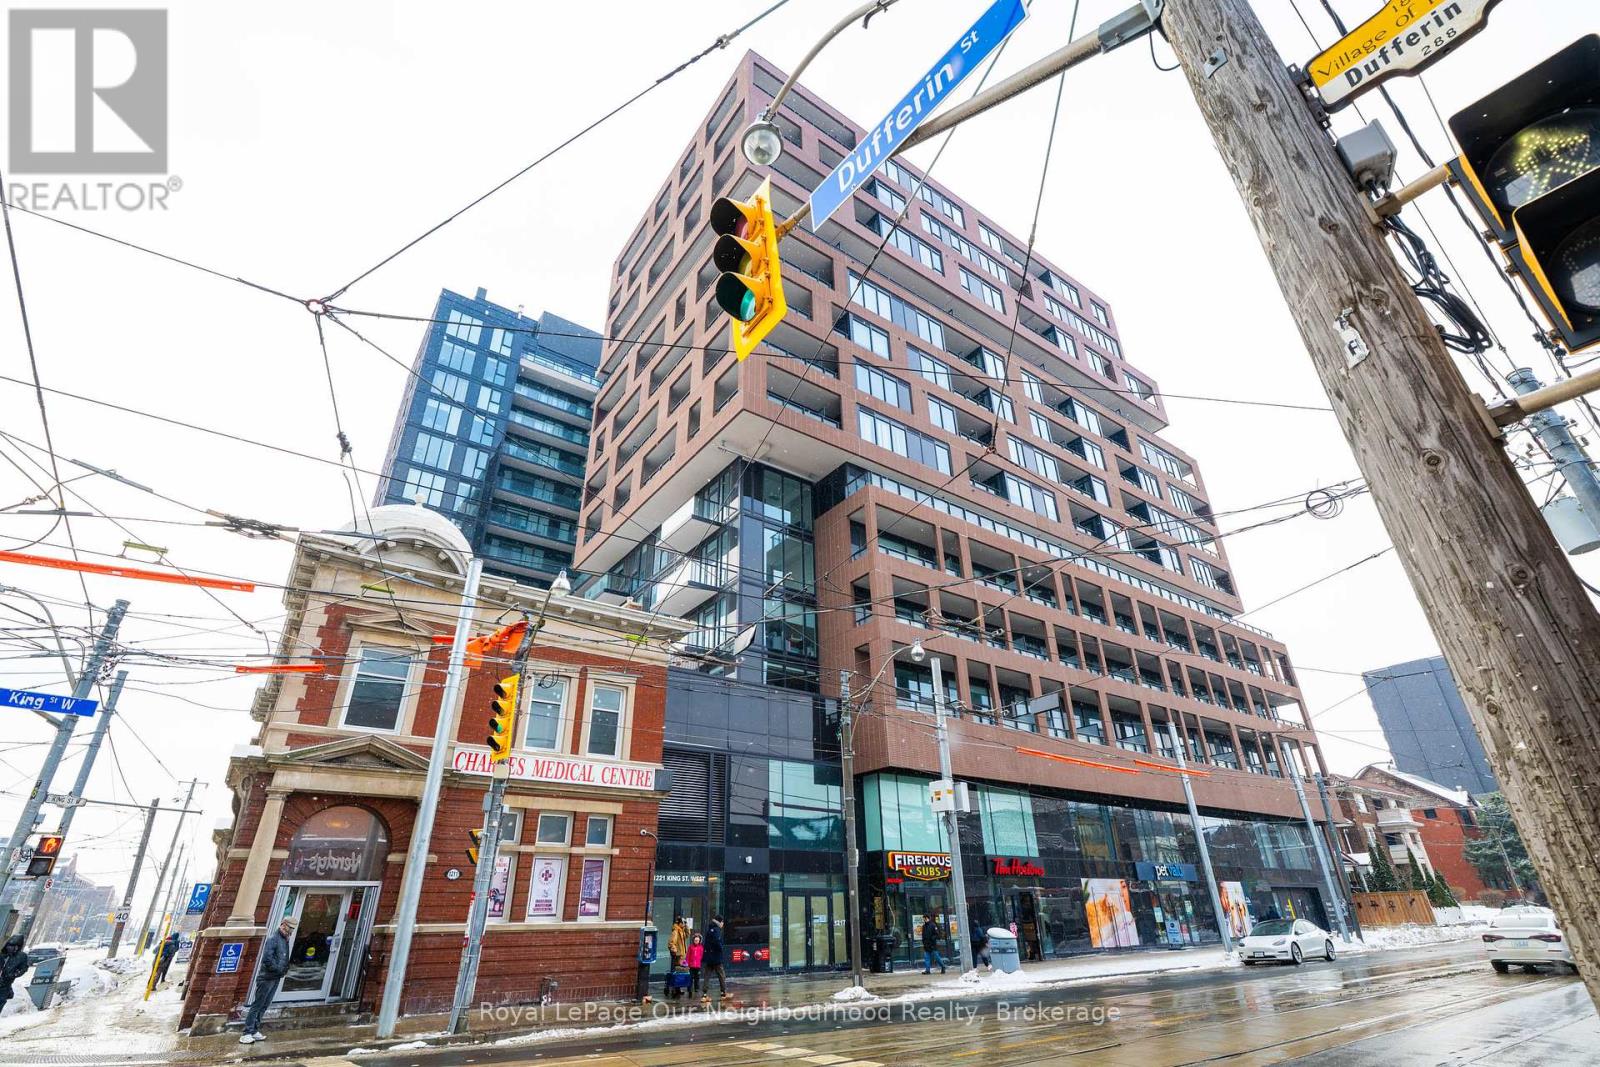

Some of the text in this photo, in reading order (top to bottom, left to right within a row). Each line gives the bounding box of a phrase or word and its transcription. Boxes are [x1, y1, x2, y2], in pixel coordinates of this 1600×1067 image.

[1317, 29, 1387, 77] Village
[1344, 2, 1462, 88] Dufferin
[1421, 28, 1457, 56] 288
[836, 29, 979, 193] Dufferin St
[8, 691, 75, 710] King St W
[531, 759, 595, 783] MEDICAL
[601, 765, 653, 788] CENTRE
[895, 854, 952, 871] FIREHOUS
[916, 866, 941, 877] SUBS
[992, 857, 1045, 877] Tim Hortons
[115, 912, 129, 920] 40
